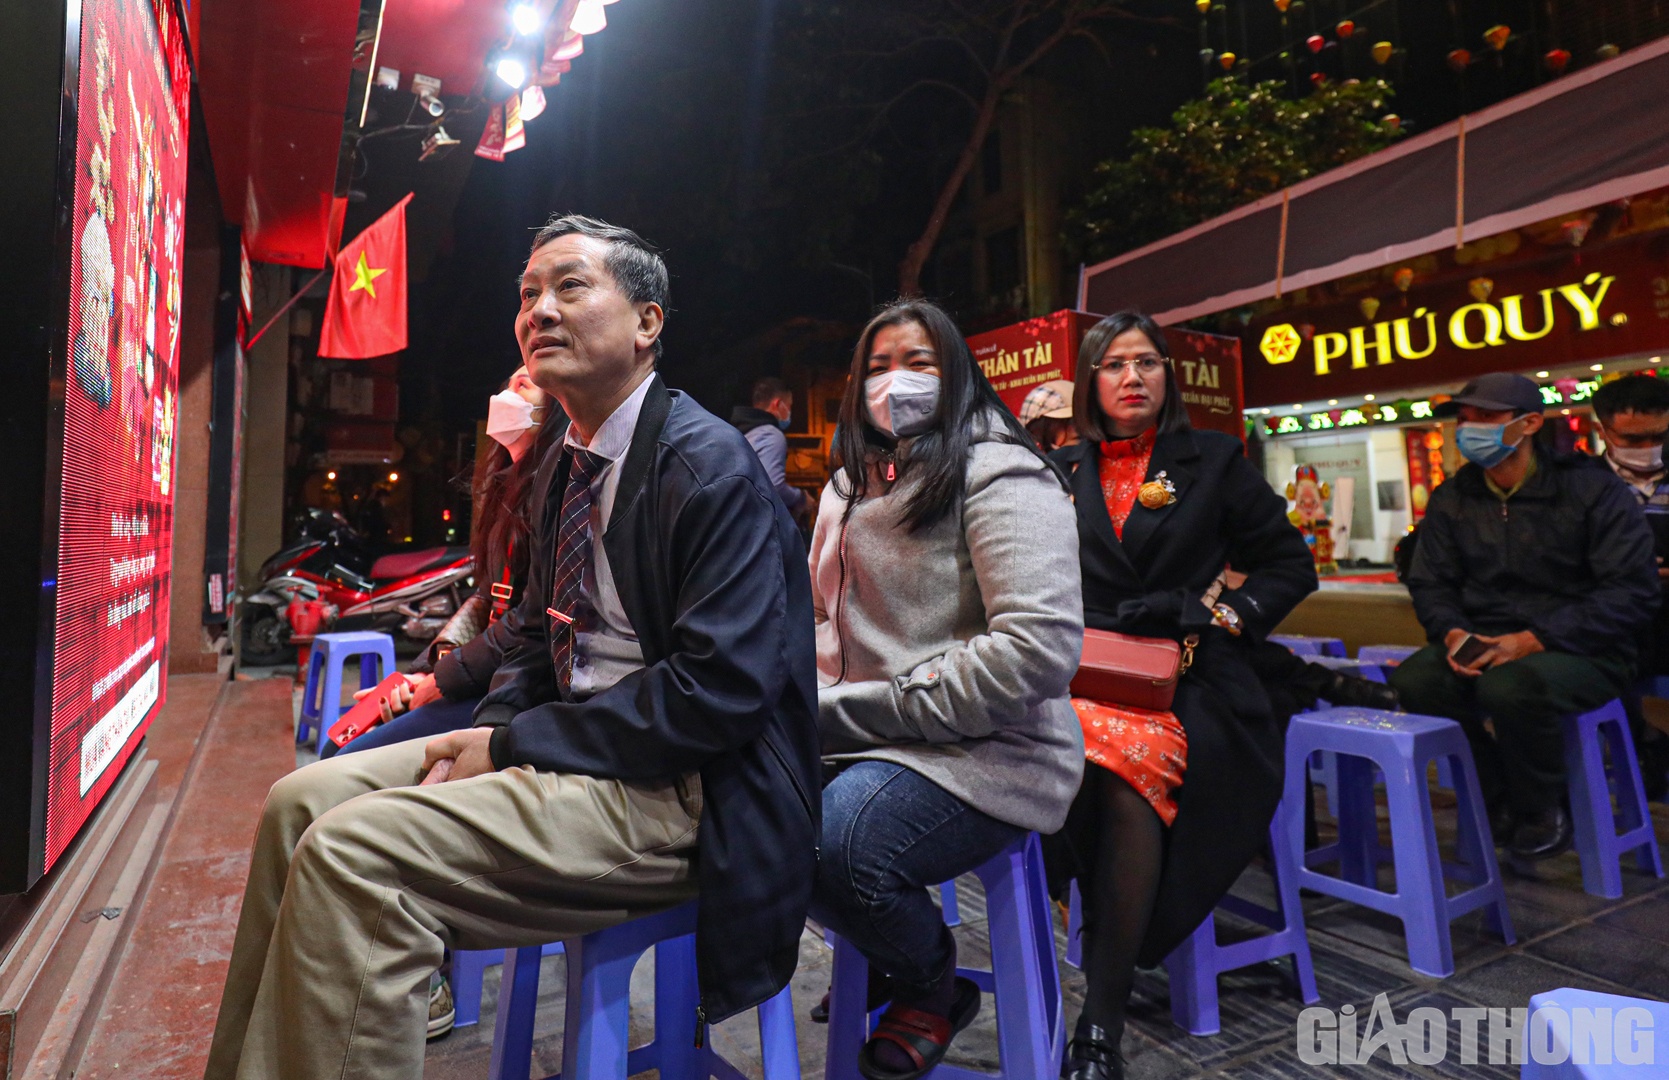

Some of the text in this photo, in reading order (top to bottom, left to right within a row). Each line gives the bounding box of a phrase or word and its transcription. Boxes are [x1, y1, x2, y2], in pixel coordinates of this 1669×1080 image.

[1312, 307, 1437, 376] PHÚ
[1448, 272, 1616, 350] QUÝ
[1022, 341, 1053, 369] TÀI
[1181, 357, 1220, 388] TÀI
